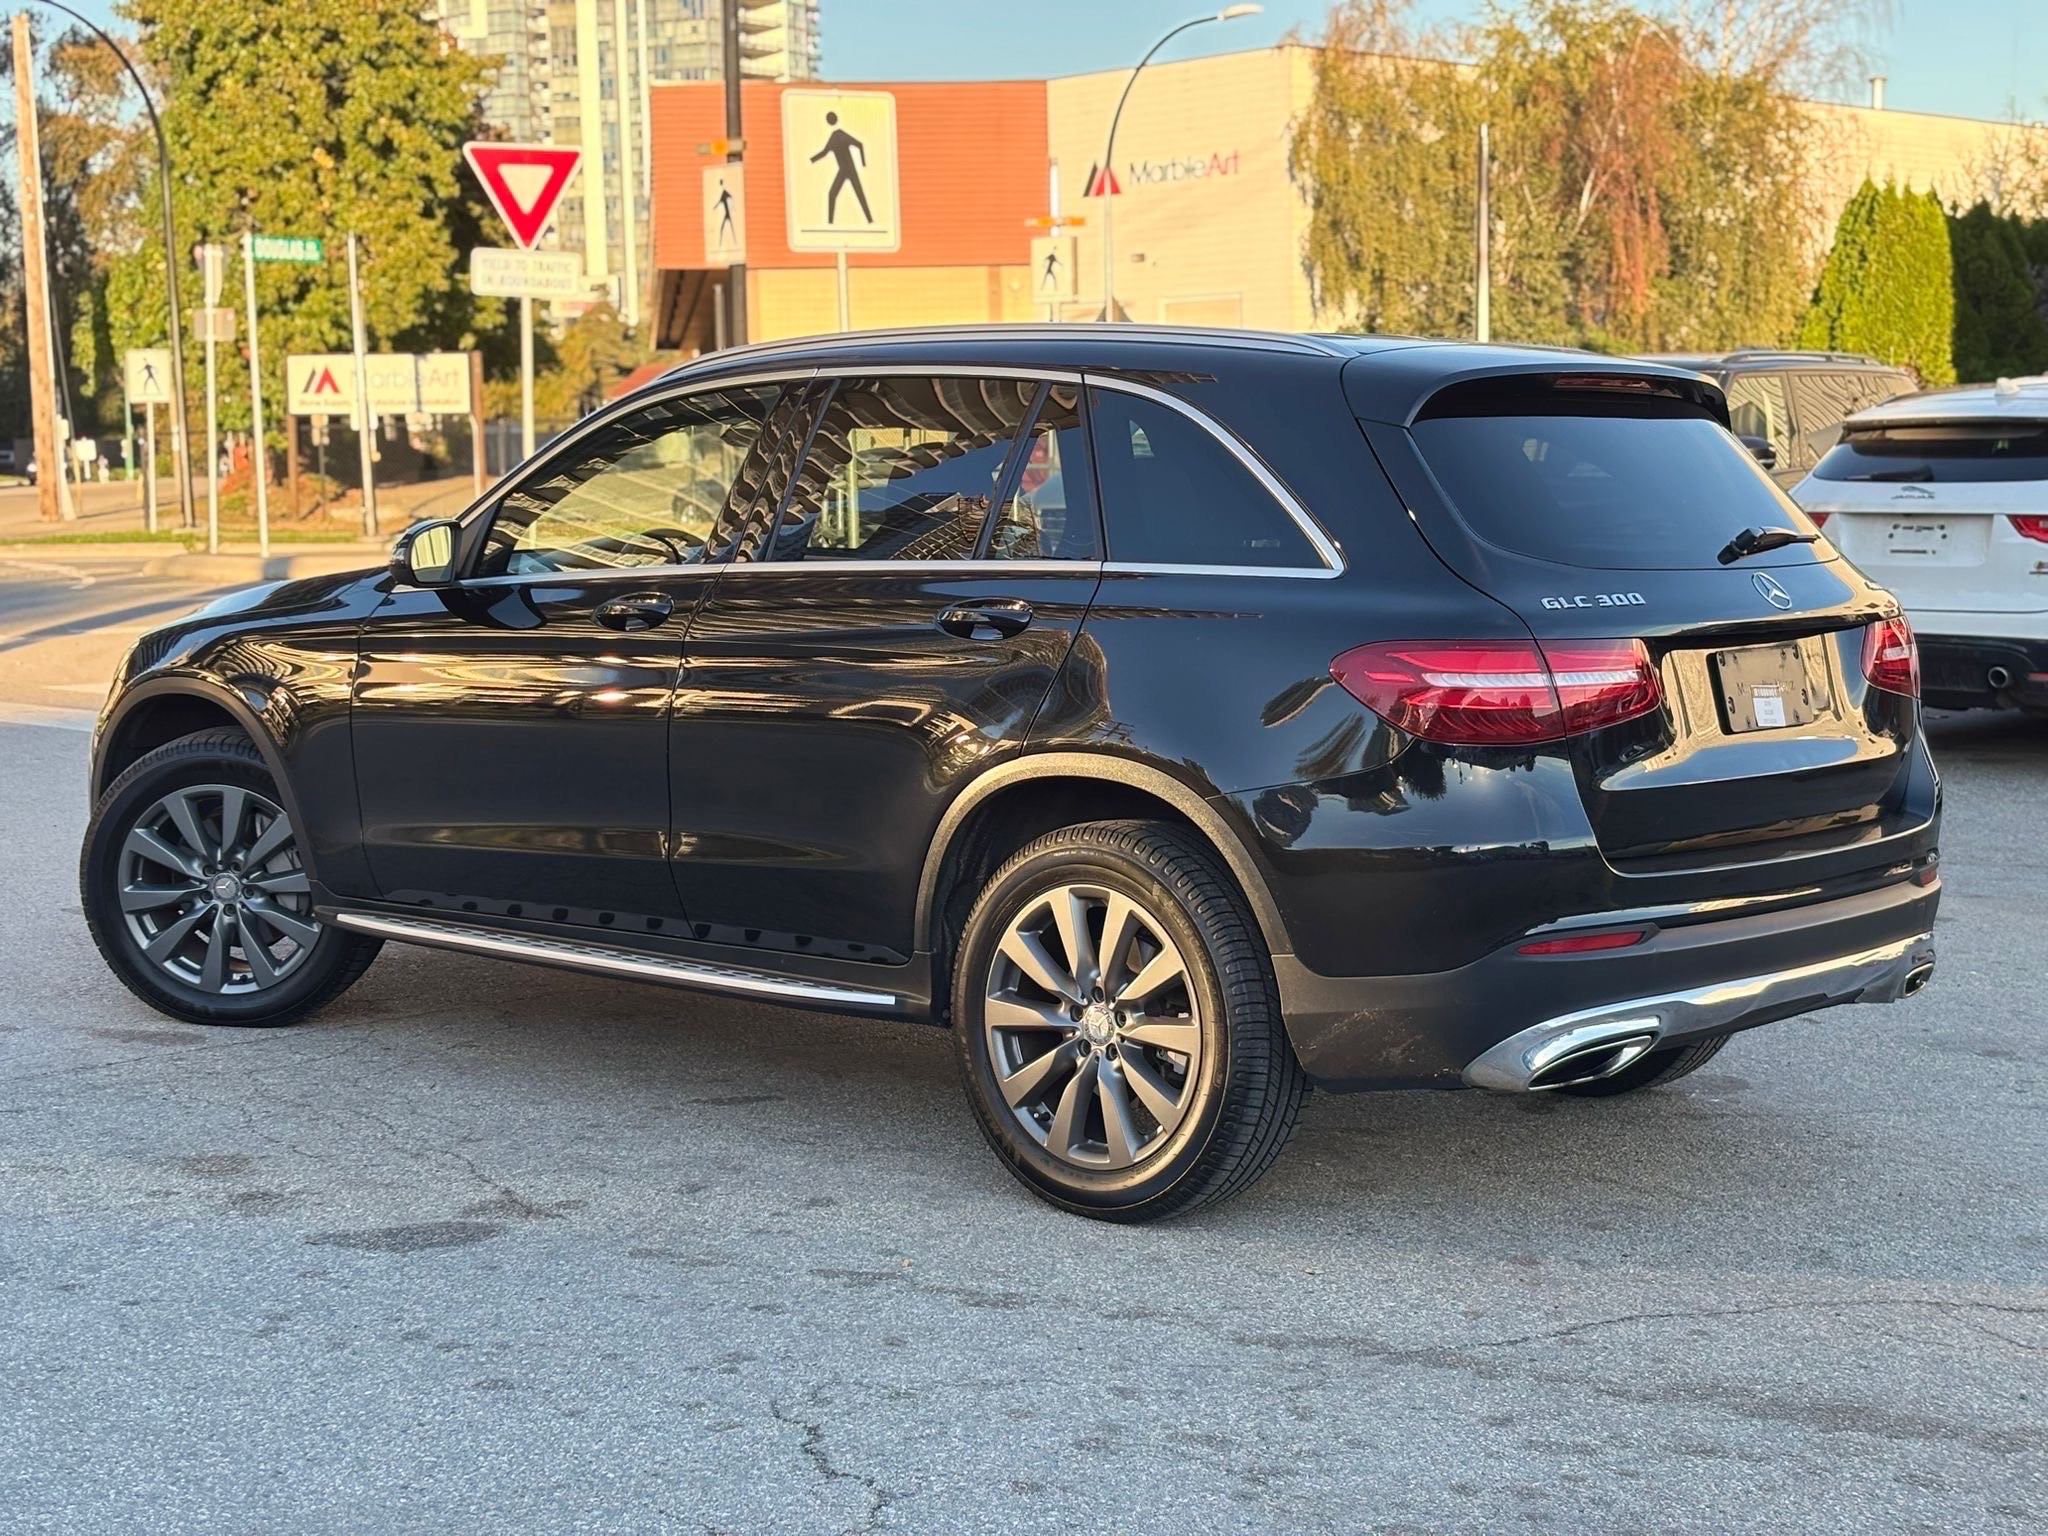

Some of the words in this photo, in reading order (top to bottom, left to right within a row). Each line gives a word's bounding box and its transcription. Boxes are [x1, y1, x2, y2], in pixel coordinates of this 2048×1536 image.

[1129, 150, 1240, 186] MarbleArt
[1540, 595, 1593, 610] GLC
[1594, 592, 1647, 607] 300
